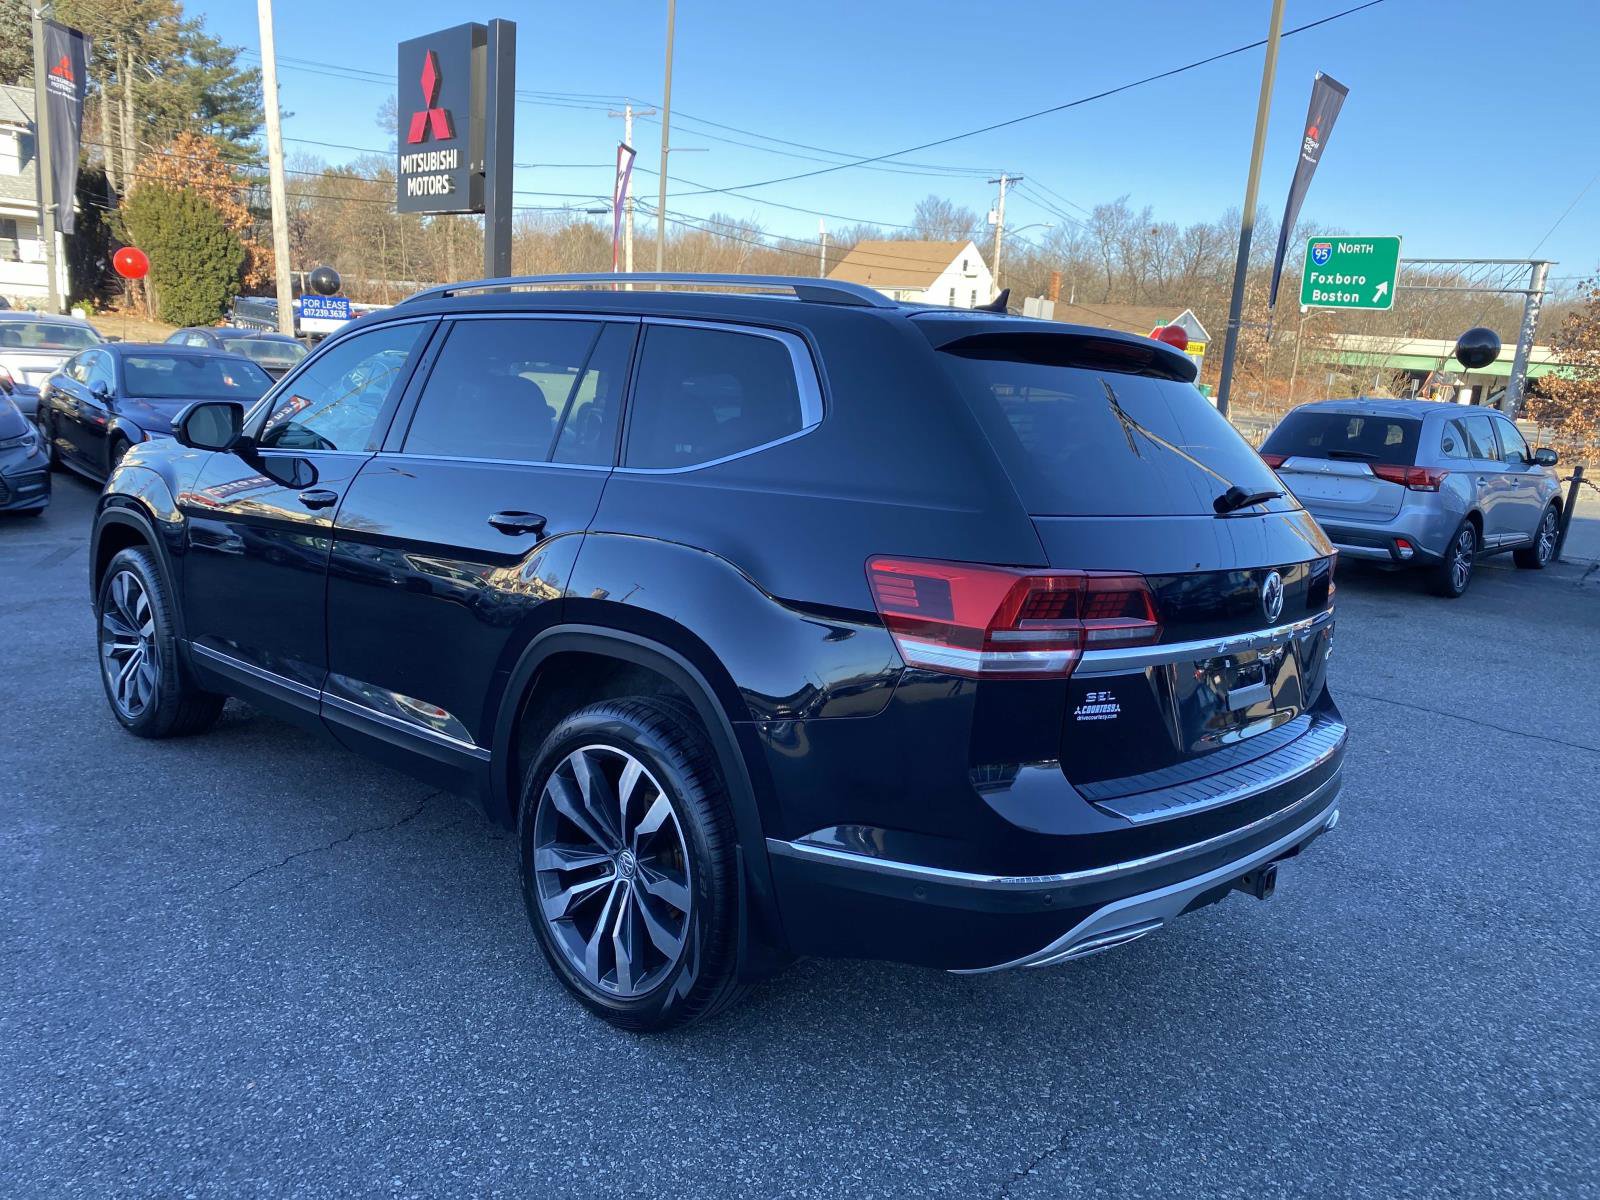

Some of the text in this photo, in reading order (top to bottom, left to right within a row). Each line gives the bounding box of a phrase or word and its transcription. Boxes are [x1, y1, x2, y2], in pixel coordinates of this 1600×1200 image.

[401, 149, 457, 174] MITSUBISHI
[408, 175, 449, 196] MOTORS
[1338, 243, 1374, 254] NORTH
[1315, 249, 1328, 260] 95
[1310, 272, 1366, 285] Foxboro
[1312, 289, 1360, 303] Boston
[303, 299, 348, 310] FOR LEASE
[303, 308, 347, 318] 617.239.3636
[1086, 691, 1116, 702] SEL
[1082, 704, 1117, 714] COURTESY
